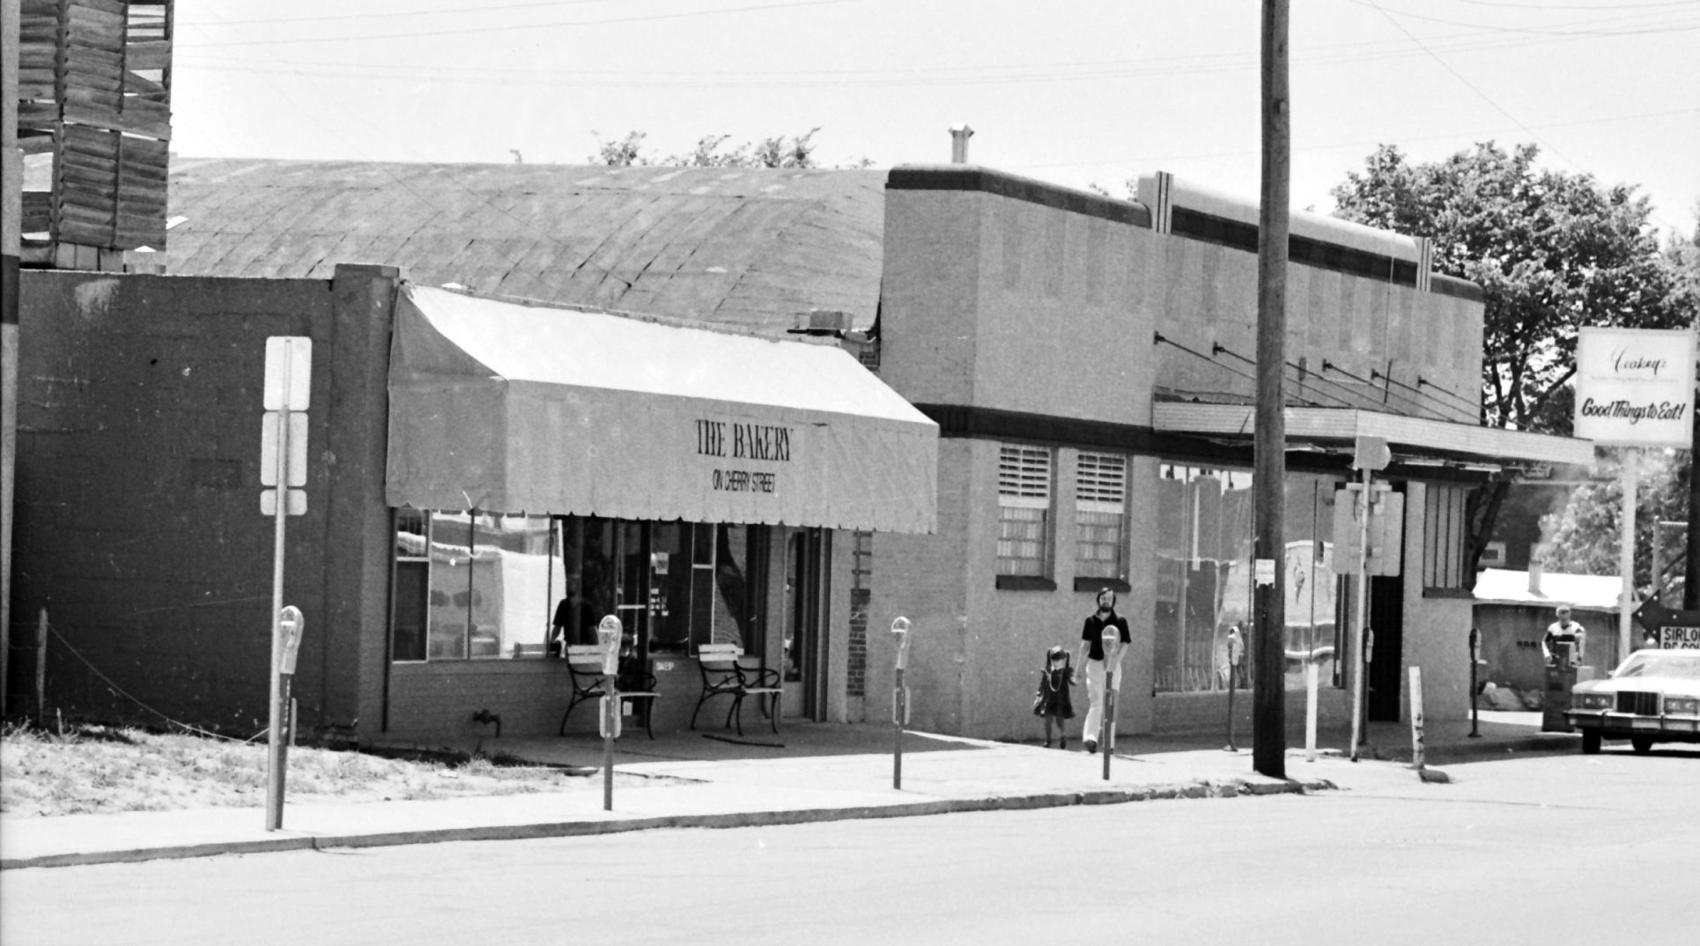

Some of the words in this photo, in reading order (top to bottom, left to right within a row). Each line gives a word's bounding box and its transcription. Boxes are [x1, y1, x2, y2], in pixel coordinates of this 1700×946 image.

[1582, 397, 1614, 417] Good
[1612, 400, 1647, 425] Things
[1647, 402, 1658, 419] to
[1657, 401, 1686, 420] Eat!
[695, 419, 727, 457] THE
[733, 423, 794, 461] BAKERY
[712, 468, 724, 491] ON
[724, 469, 751, 492] CHERRY
[752, 471, 776, 493] STREET
[1664, 627, 1700, 642] SIRLO
